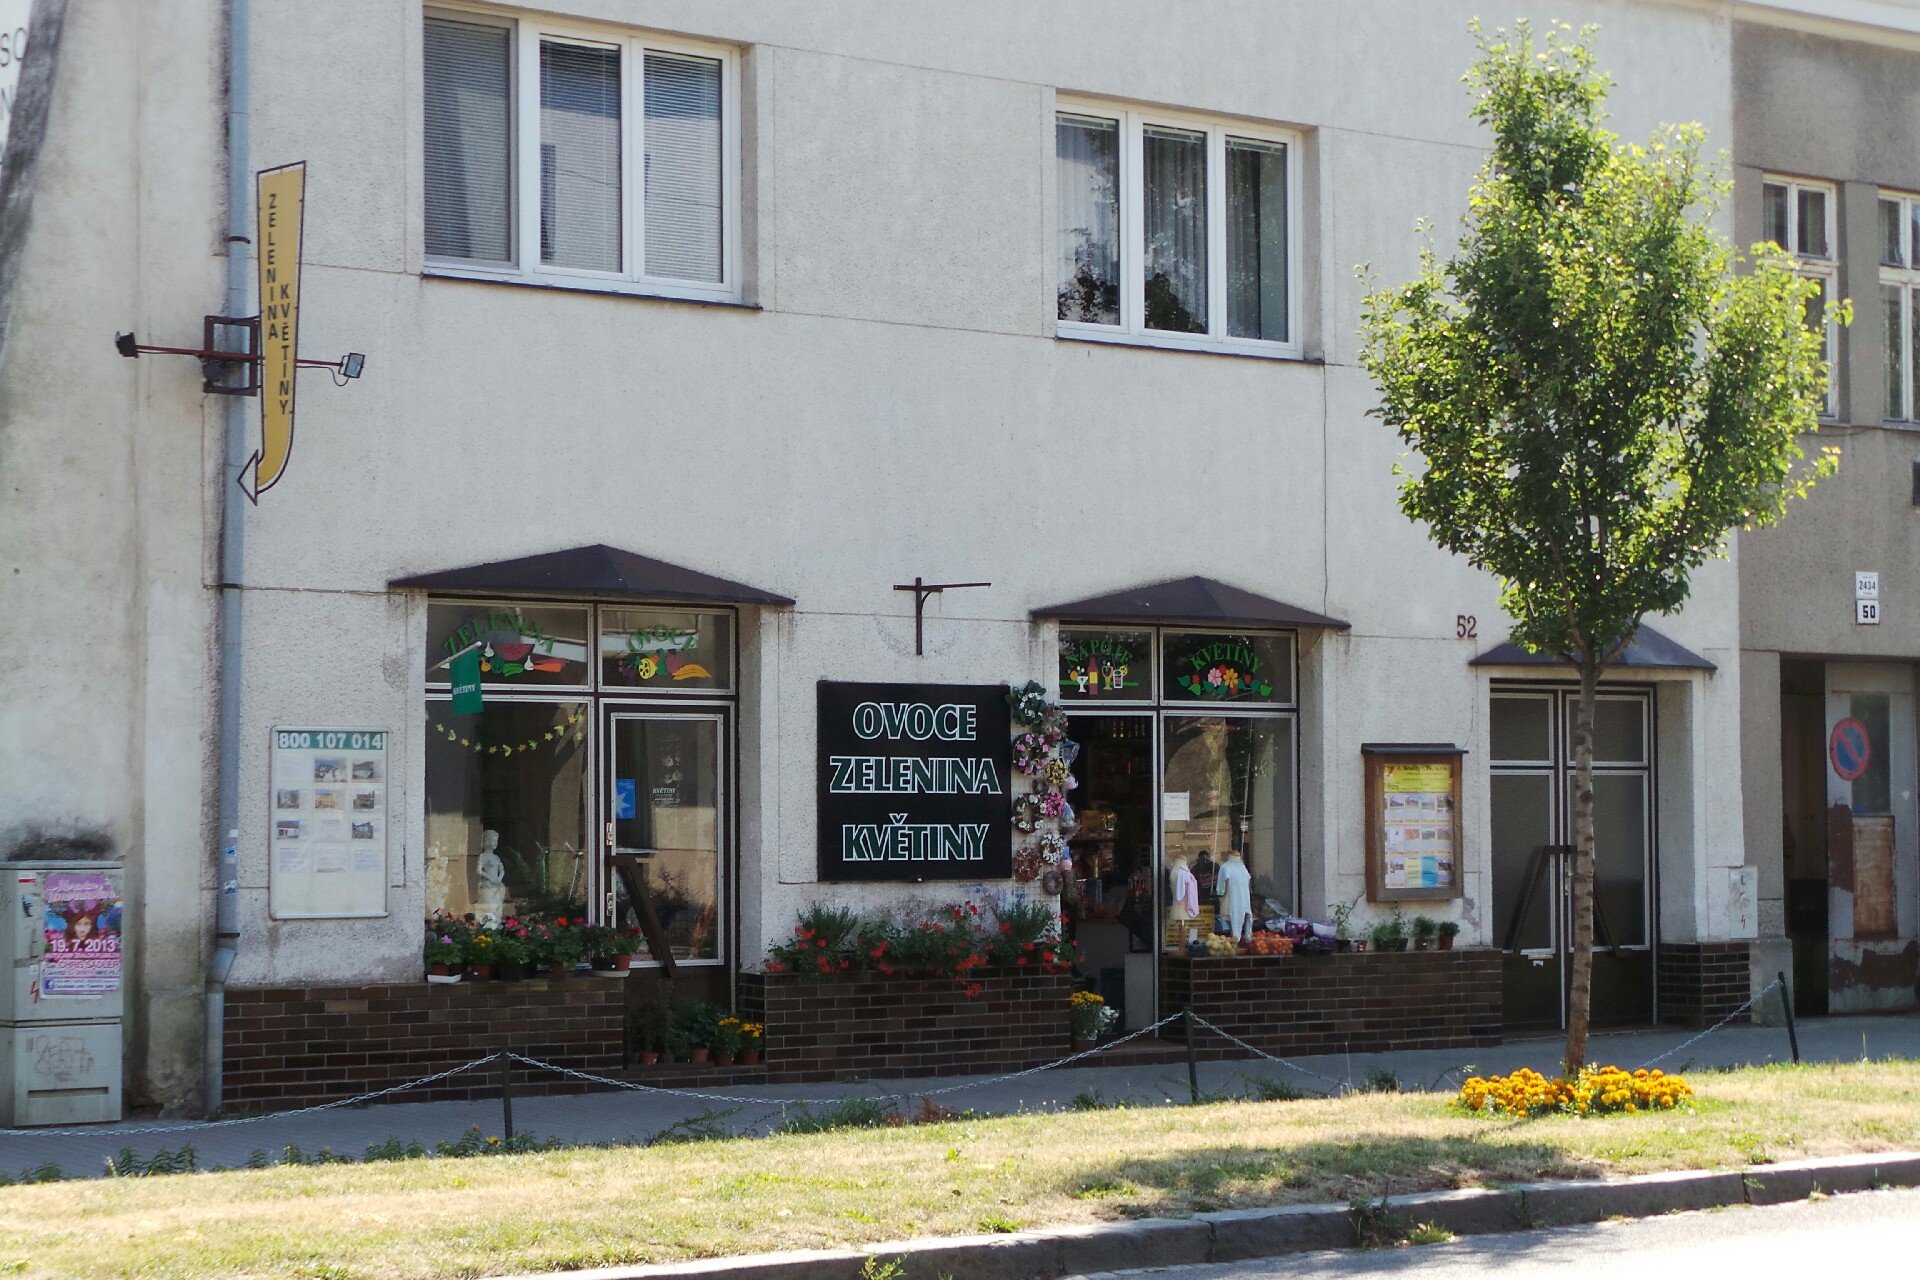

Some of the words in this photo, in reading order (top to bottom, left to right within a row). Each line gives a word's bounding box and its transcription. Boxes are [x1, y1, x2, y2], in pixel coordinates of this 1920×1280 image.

[265, 193, 279, 340] ZELENINA
[279, 284, 291, 415] KVĚTINY
[1859, 580, 1876, 590] 2434
[1457, 614, 1478, 639] 52
[1862, 604, 1876, 619] 50
[852, 701, 977, 741] OVOCE
[279, 732, 311, 749] 800
[316, 732, 347, 749] 107
[351, 733, 382, 750] 014
[829, 756, 1003, 795] ZELENINA
[842, 813, 990, 862] KVĚTINY
[50, 938, 70, 953] 19.
[72, 939, 83, 953] 7.
[84, 938, 116, 953] 2013
